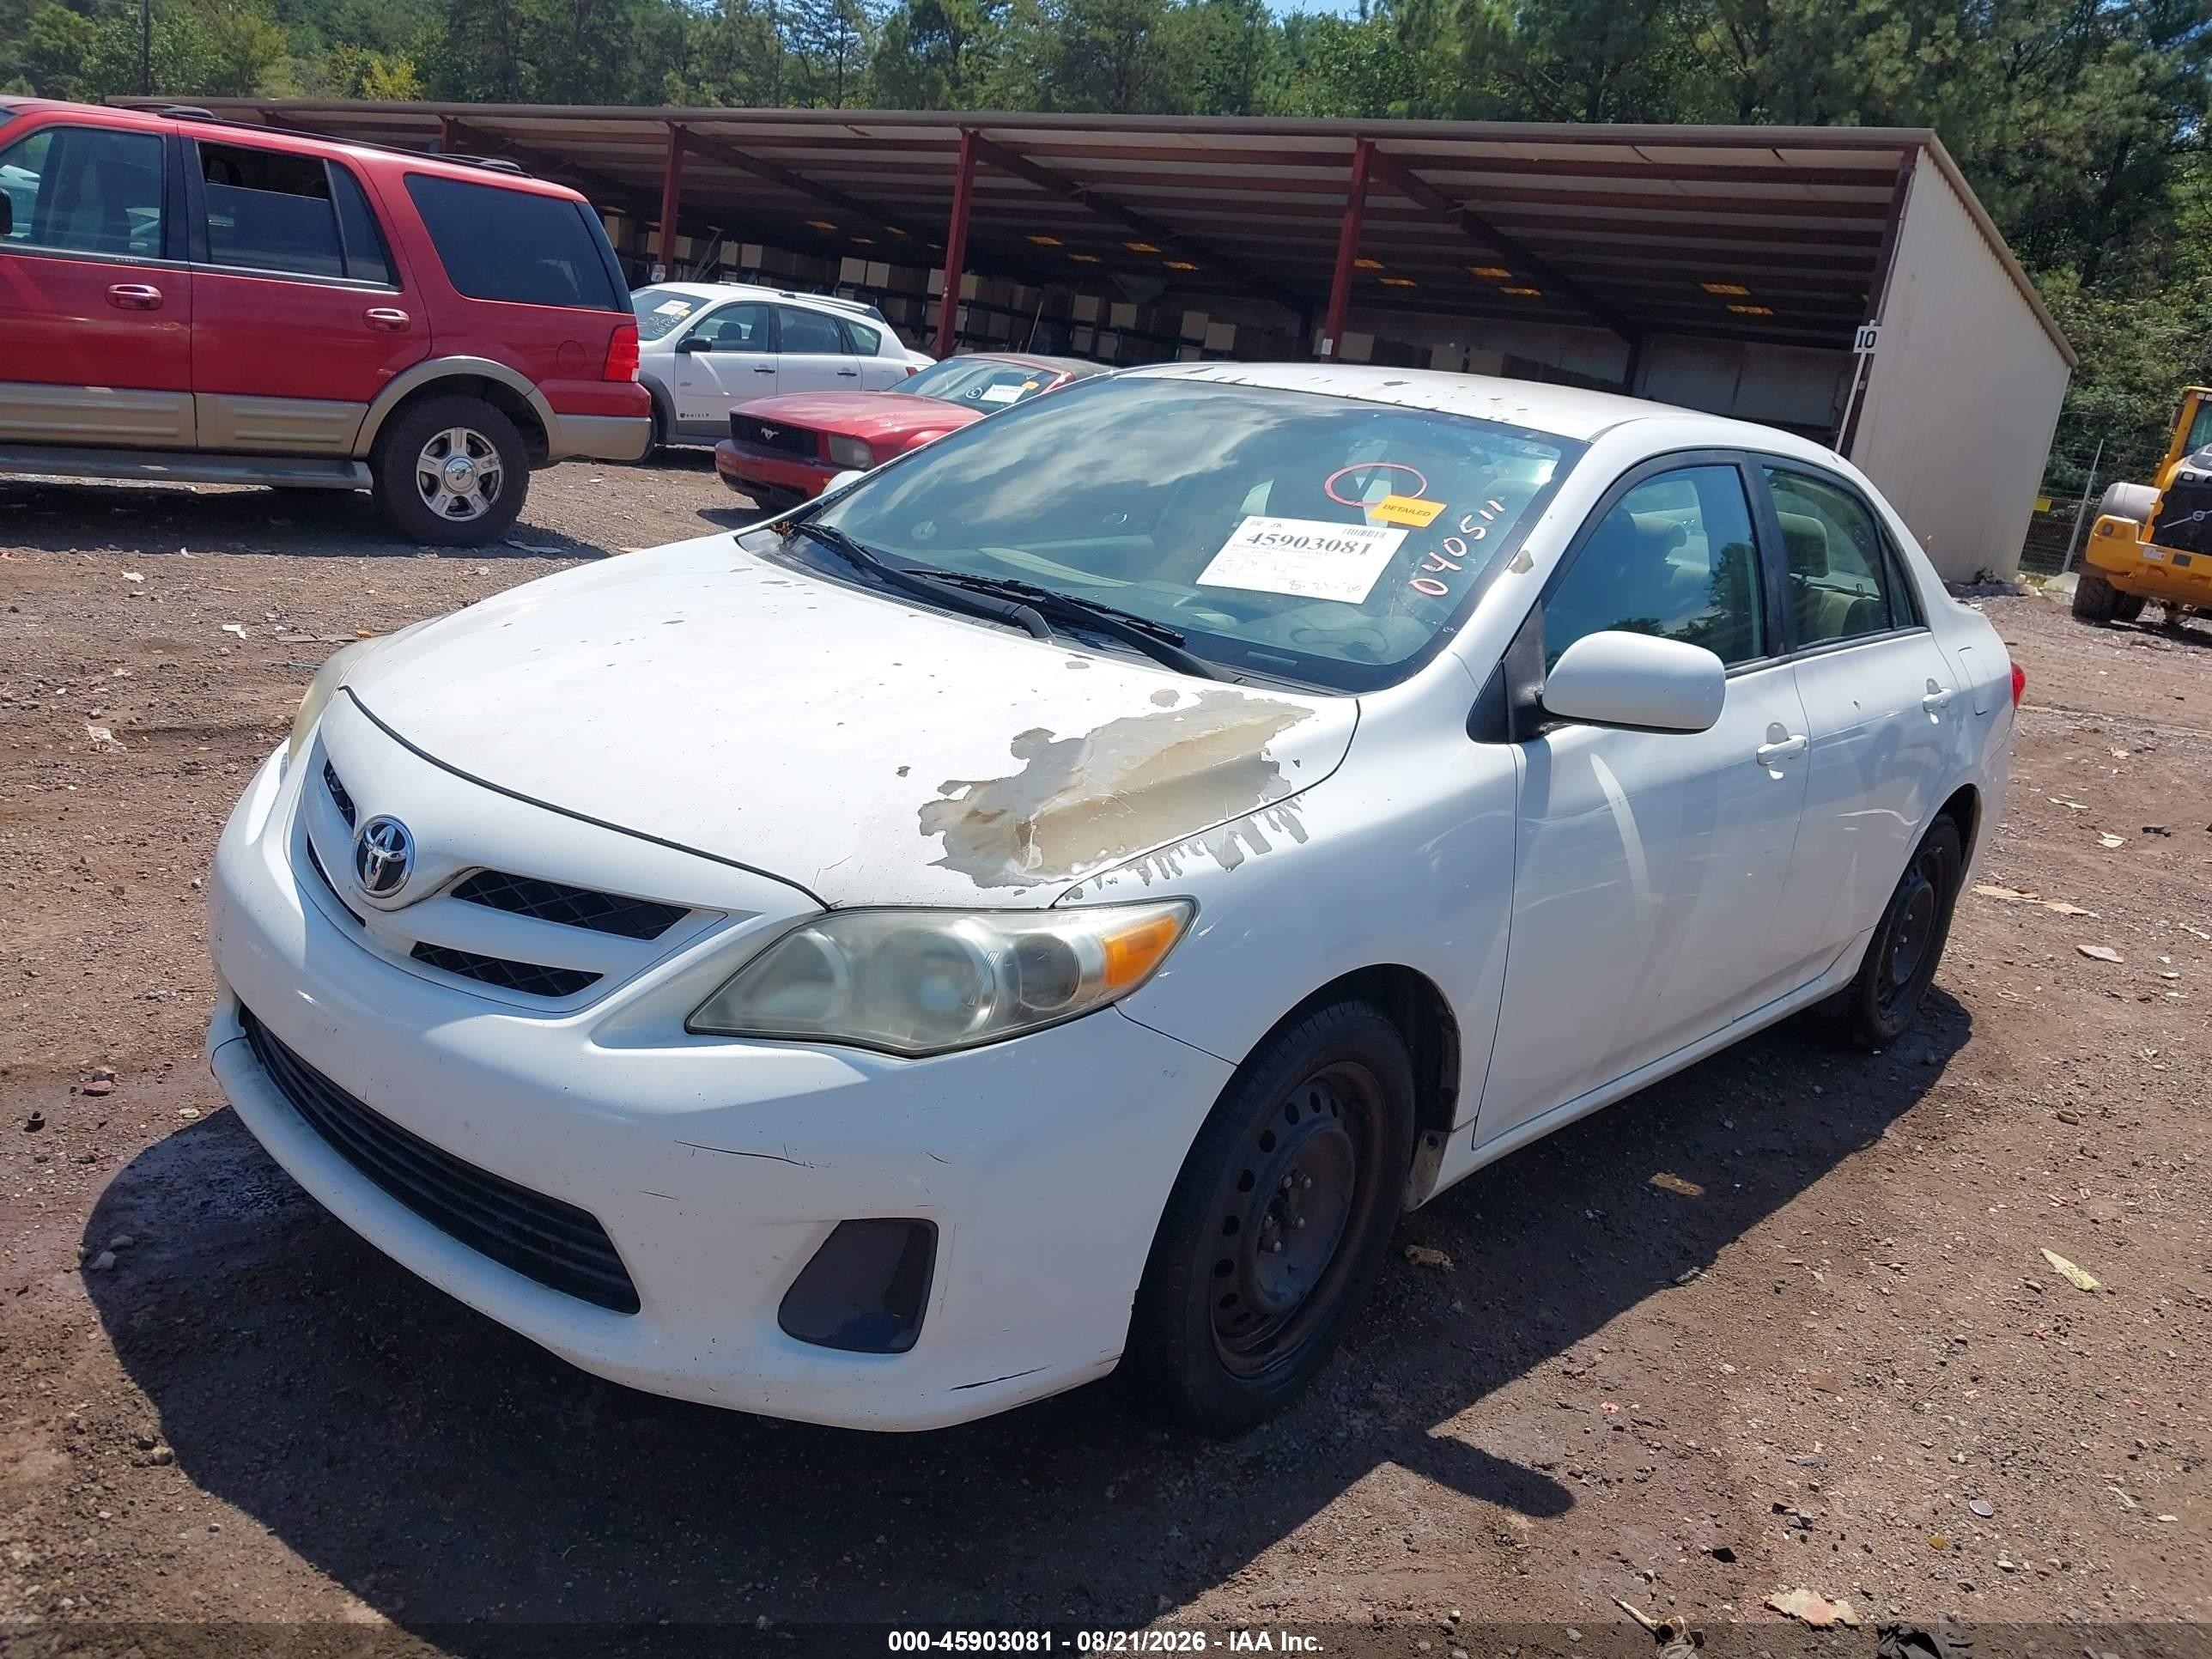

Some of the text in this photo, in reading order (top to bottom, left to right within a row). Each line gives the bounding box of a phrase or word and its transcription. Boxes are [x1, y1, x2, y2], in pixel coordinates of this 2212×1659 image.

[1857, 331, 1877, 349] 10
[1382, 503, 1431, 517] DETAILED
[1246, 532, 1374, 556] 45903081
[1408, 500, 1505, 596] 040511
